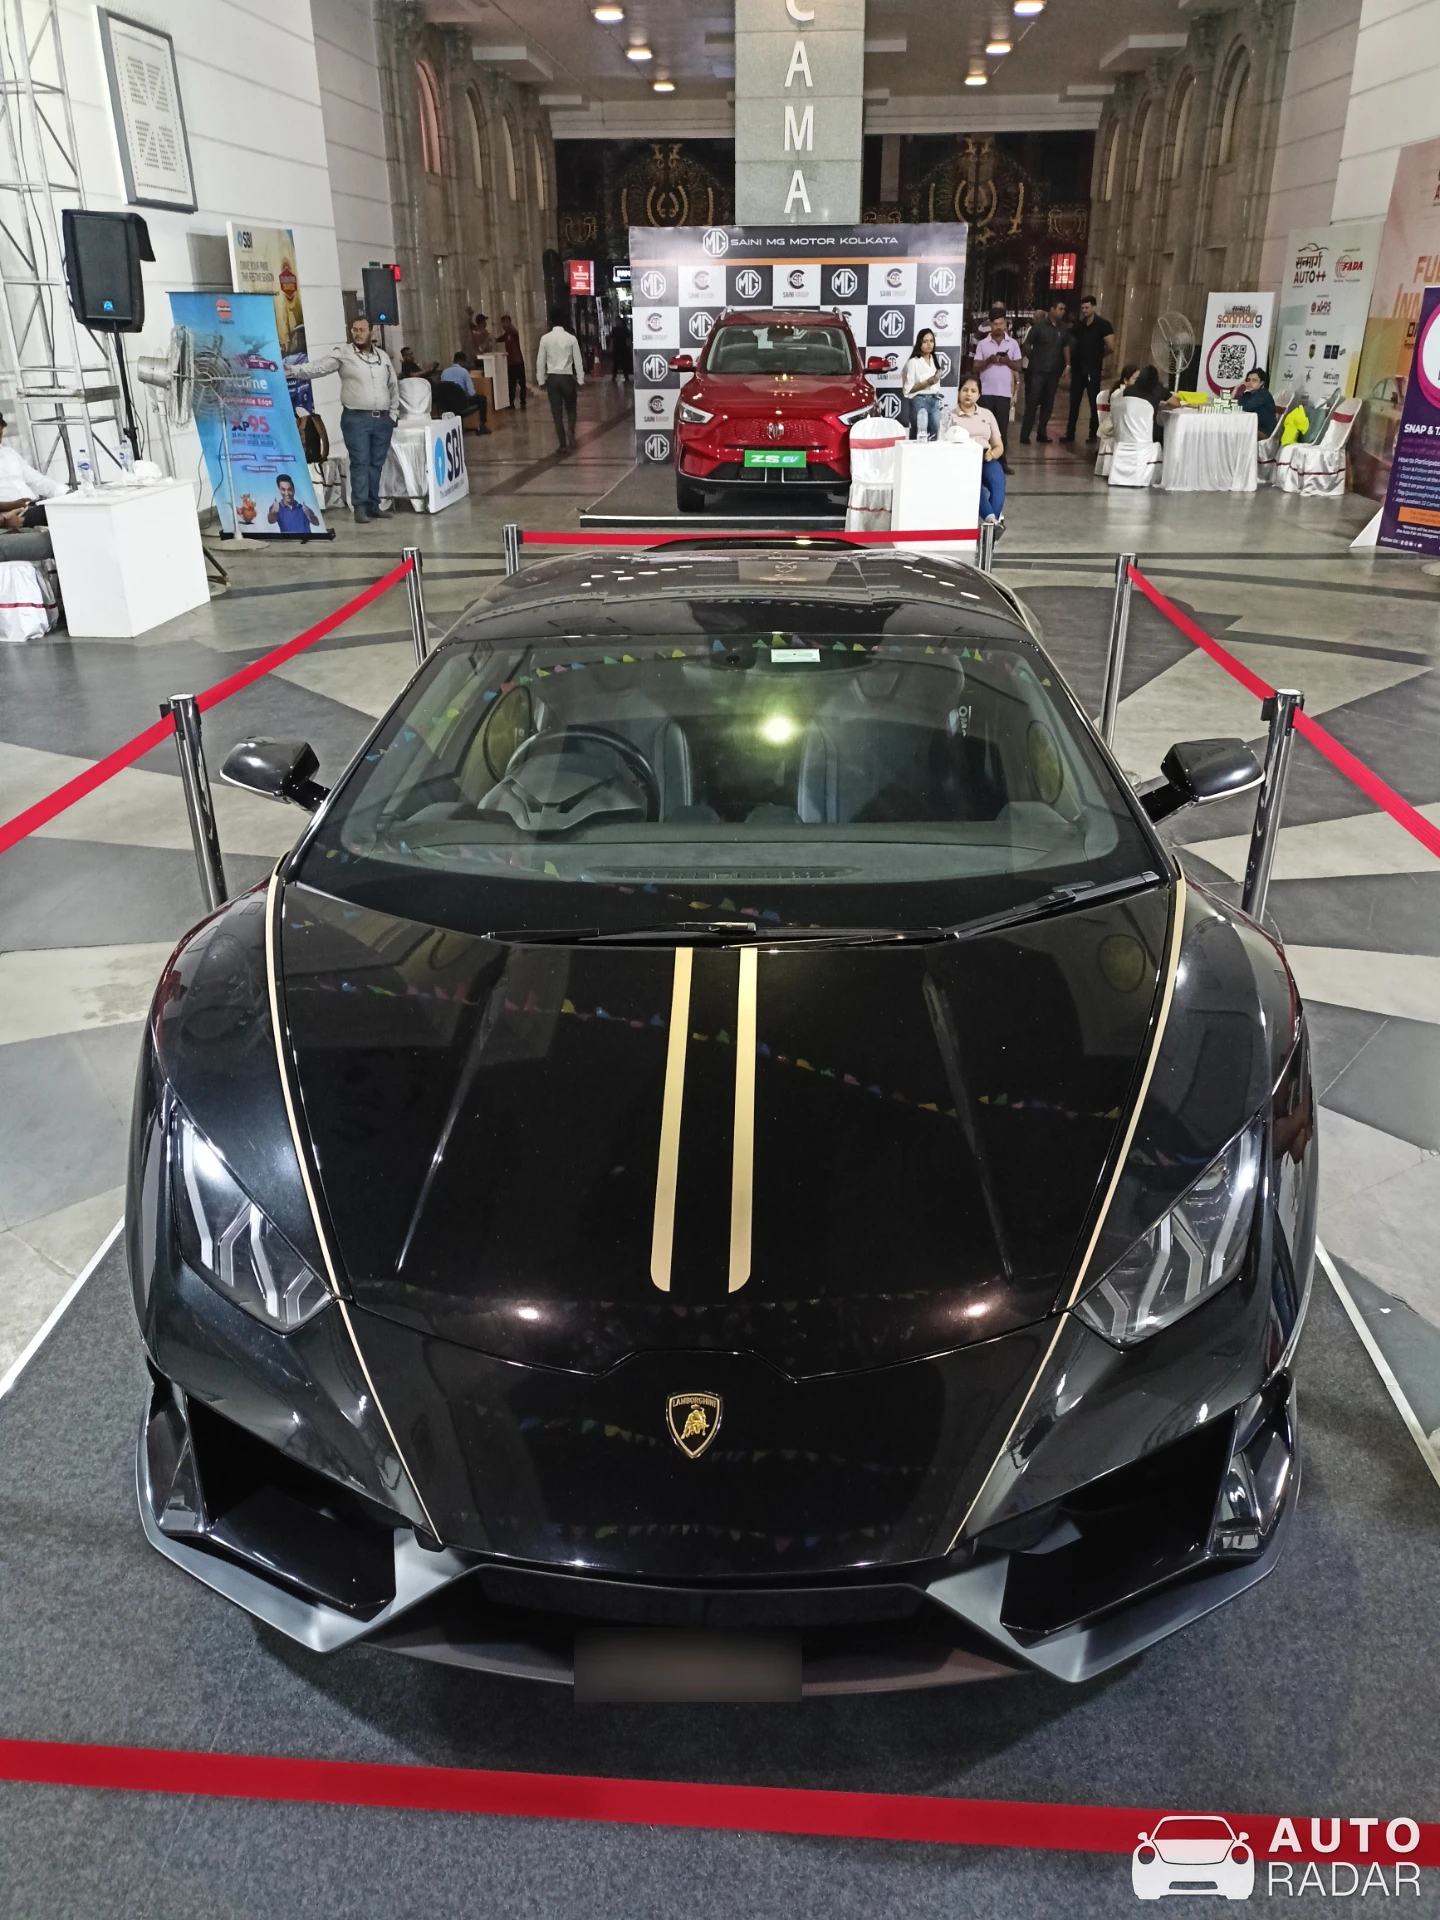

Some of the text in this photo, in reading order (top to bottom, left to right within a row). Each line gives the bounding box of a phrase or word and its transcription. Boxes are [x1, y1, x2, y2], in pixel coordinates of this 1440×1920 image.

[242, 231, 253, 249] SBI
[730, 238, 762, 246] SAINI
[766, 238, 785, 246] MG
[789, 237, 835, 246] MOTOR
[839, 236, 899, 245] KOLKATA
[1341, 261, 1364, 271] FADA
[641, 271, 666, 299] MG
[736, 270, 761, 298] MG
[832, 269, 857, 297] MG
[879, 310, 905, 338] MG
[1217, 314, 1263, 328] sanmarg
[643, 354, 668, 382] MG
[1404, 424, 1427, 434] SNAP
[1427, 426, 1434, 435] &
[446, 425, 464, 482] SBI
[645, 434, 669, 460] MG
[751, 455, 780, 463] ZS
[672, 1396, 716, 1408] LAMBORGHINI
